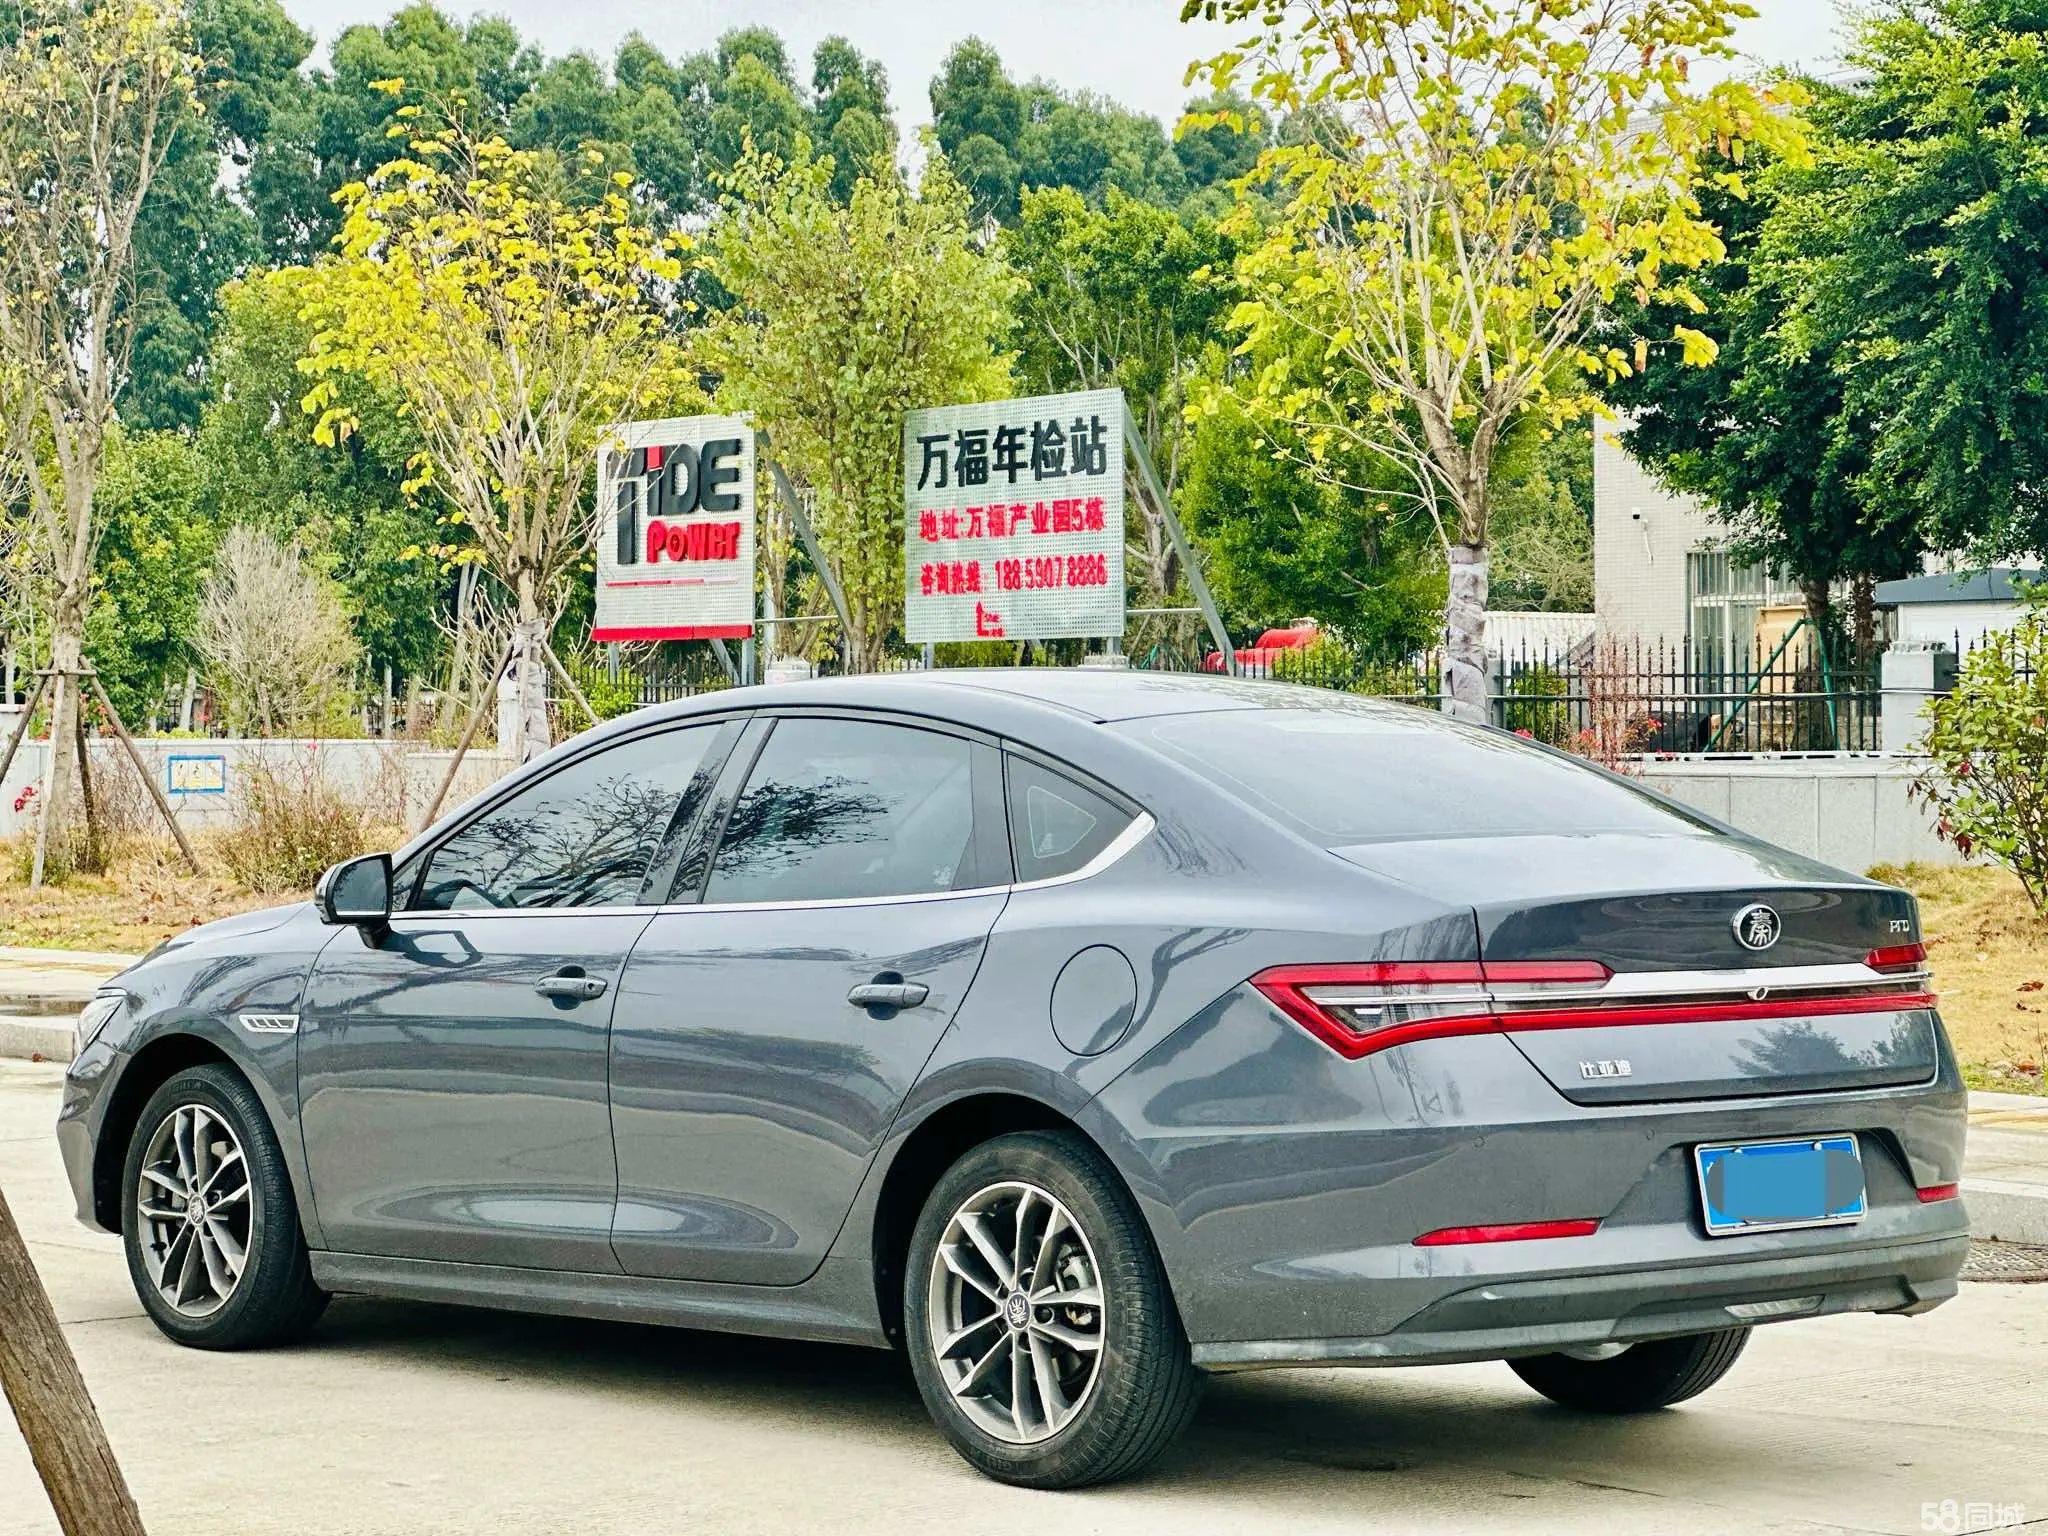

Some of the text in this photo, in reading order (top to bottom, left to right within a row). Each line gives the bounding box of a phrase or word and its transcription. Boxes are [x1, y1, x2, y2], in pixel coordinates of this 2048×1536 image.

[917, 416, 1108, 491] 万福年检站
